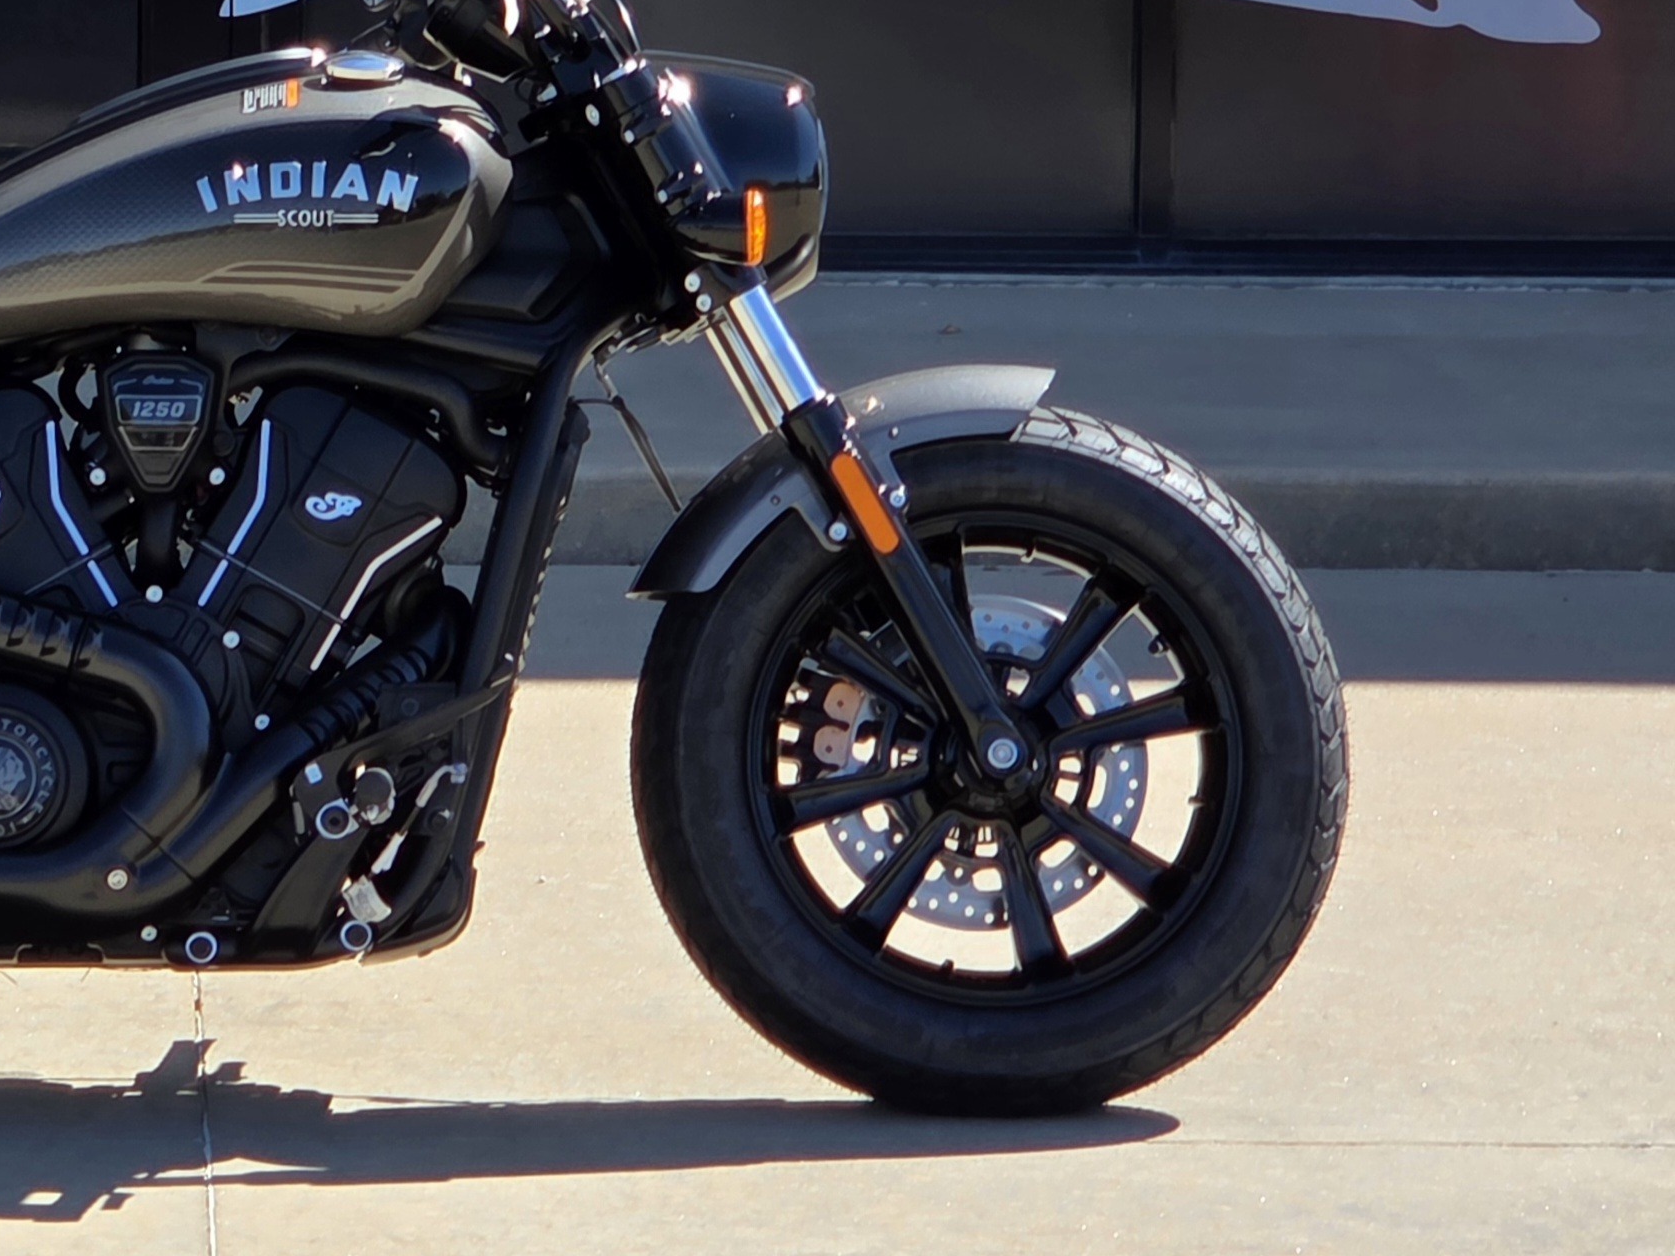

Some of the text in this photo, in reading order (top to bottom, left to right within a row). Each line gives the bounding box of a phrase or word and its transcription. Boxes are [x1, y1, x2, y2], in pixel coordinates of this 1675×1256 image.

[196, 160, 419, 213] INDIAN
[277, 209, 335, 228] SCOUT
[132, 400, 186, 418] 1250
